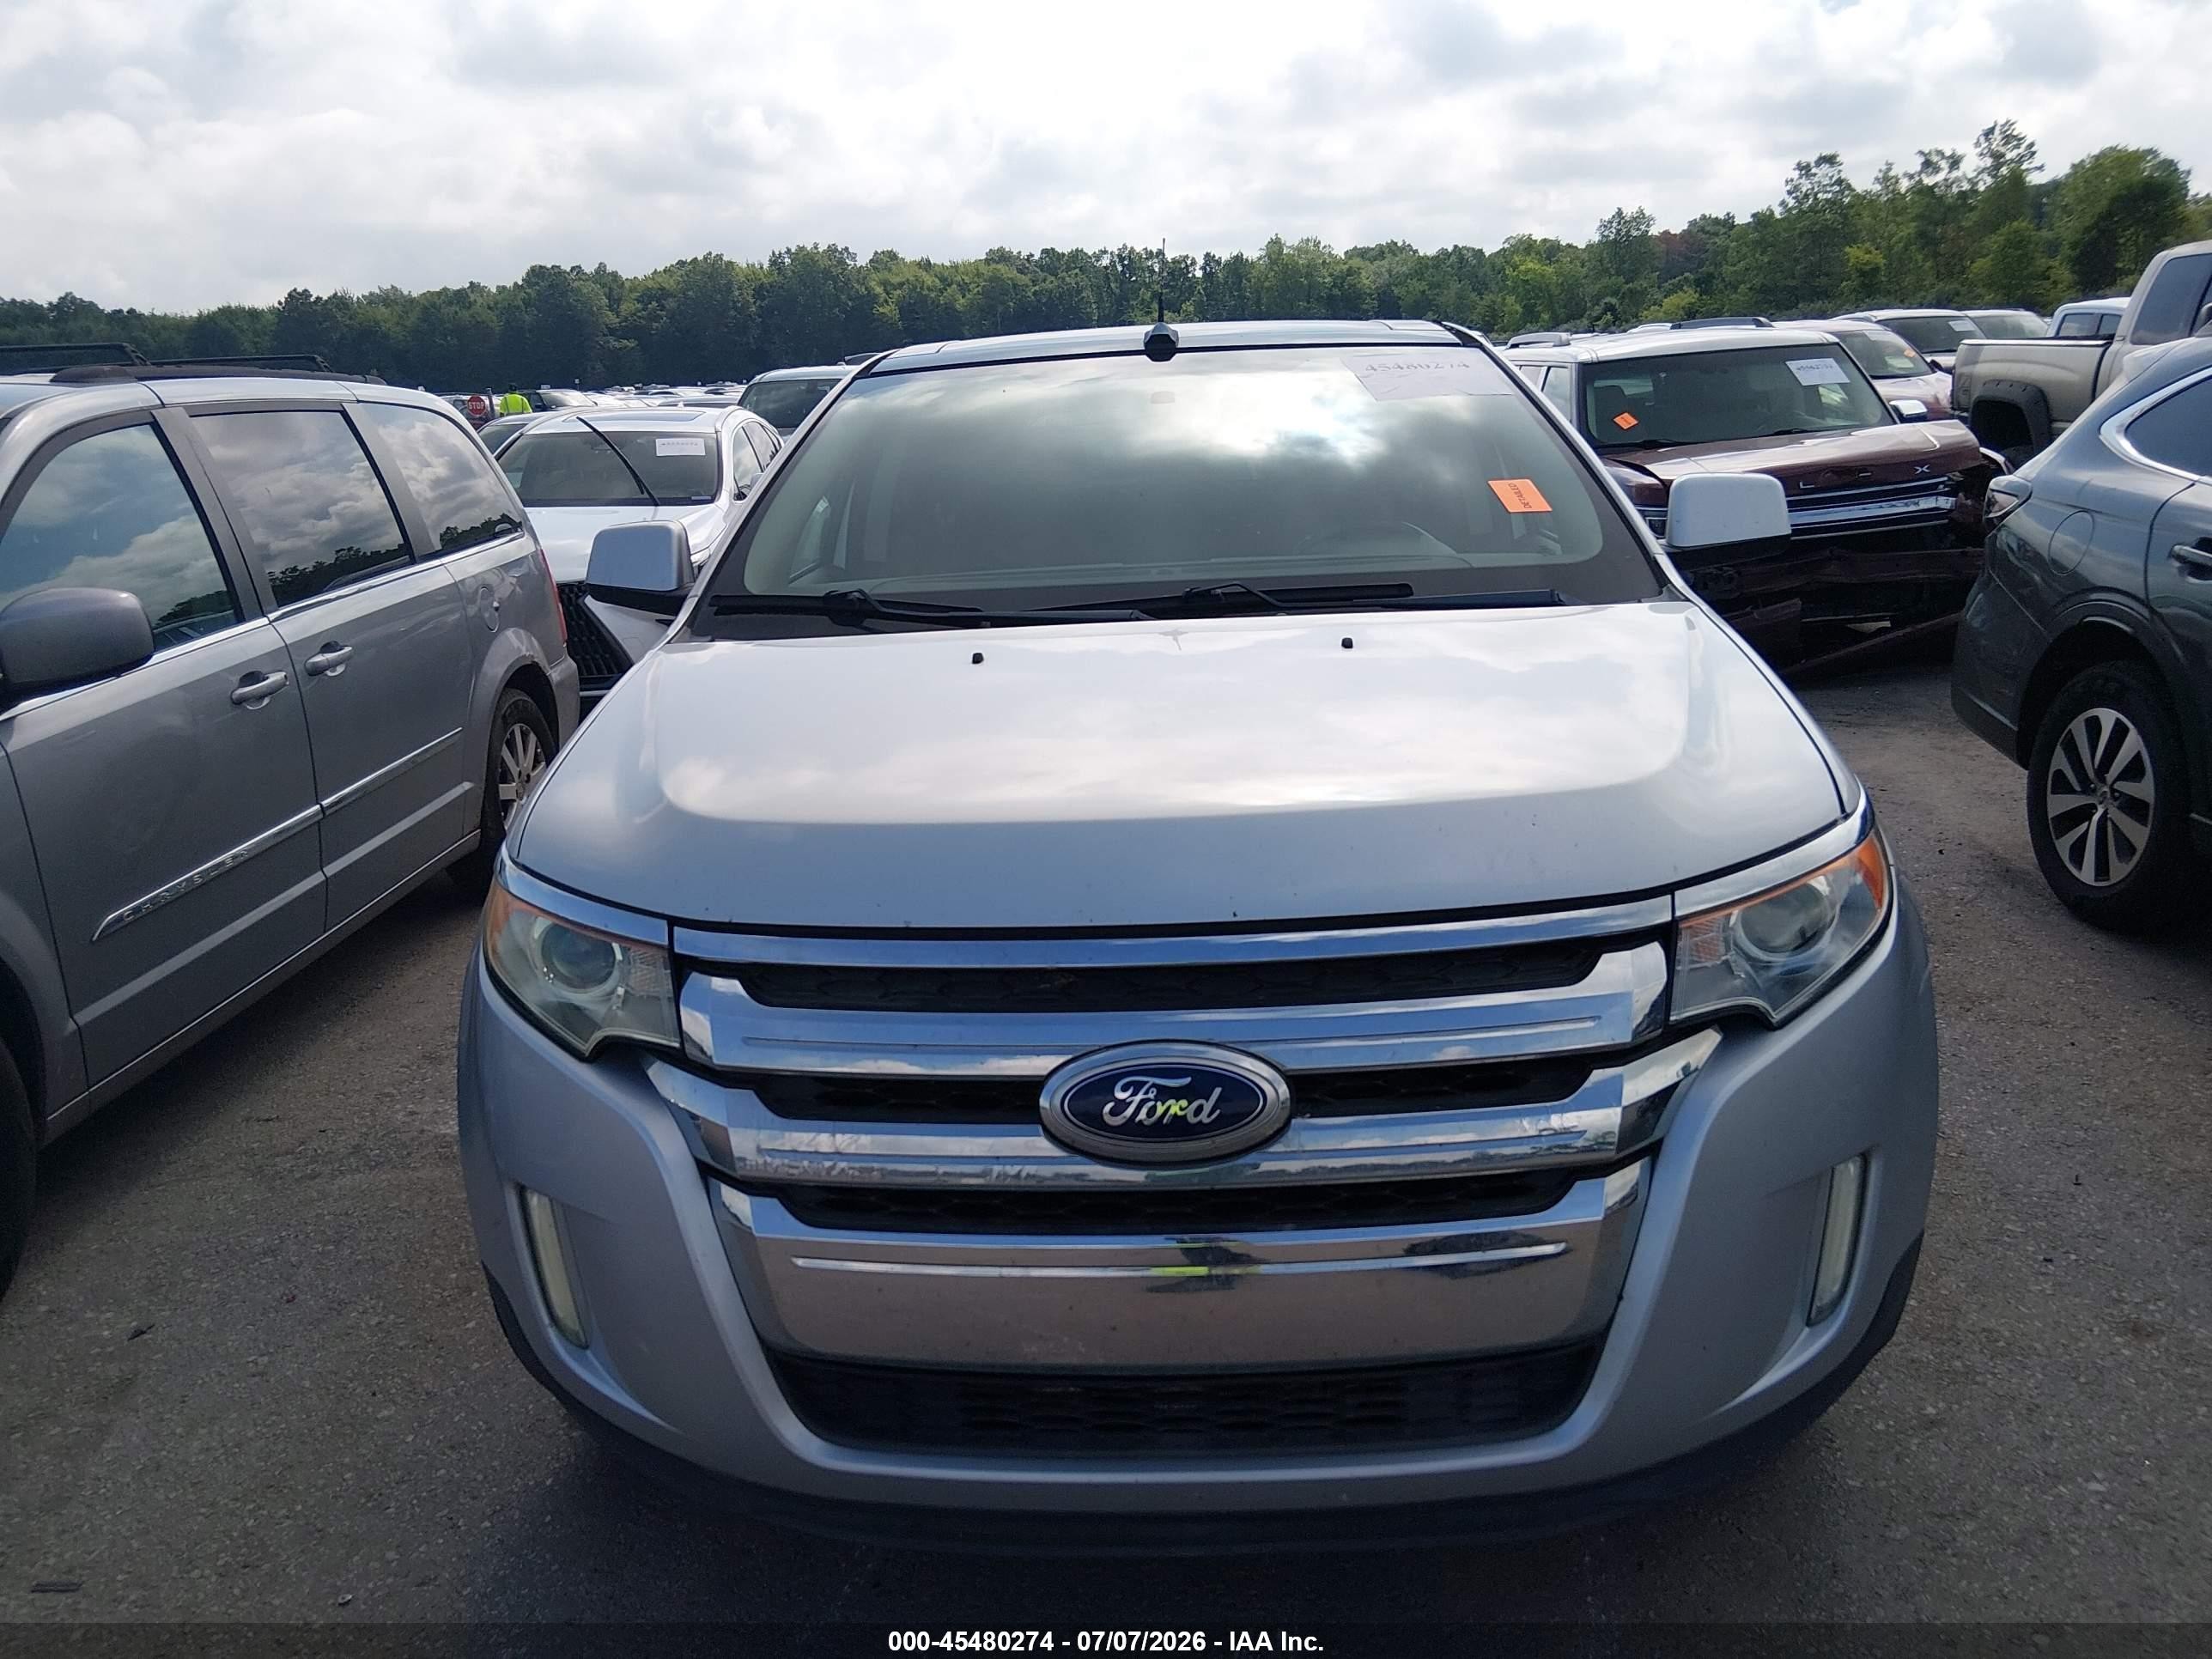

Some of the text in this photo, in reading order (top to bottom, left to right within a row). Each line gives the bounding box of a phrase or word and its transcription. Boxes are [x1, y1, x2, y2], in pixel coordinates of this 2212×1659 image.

[468, 401, 485, 410] STOP
[1508, 483, 1533, 508] DETAILED
[124, 849, 249, 921] CHRYSLER
[1102, 1075, 1222, 1127] Ford
